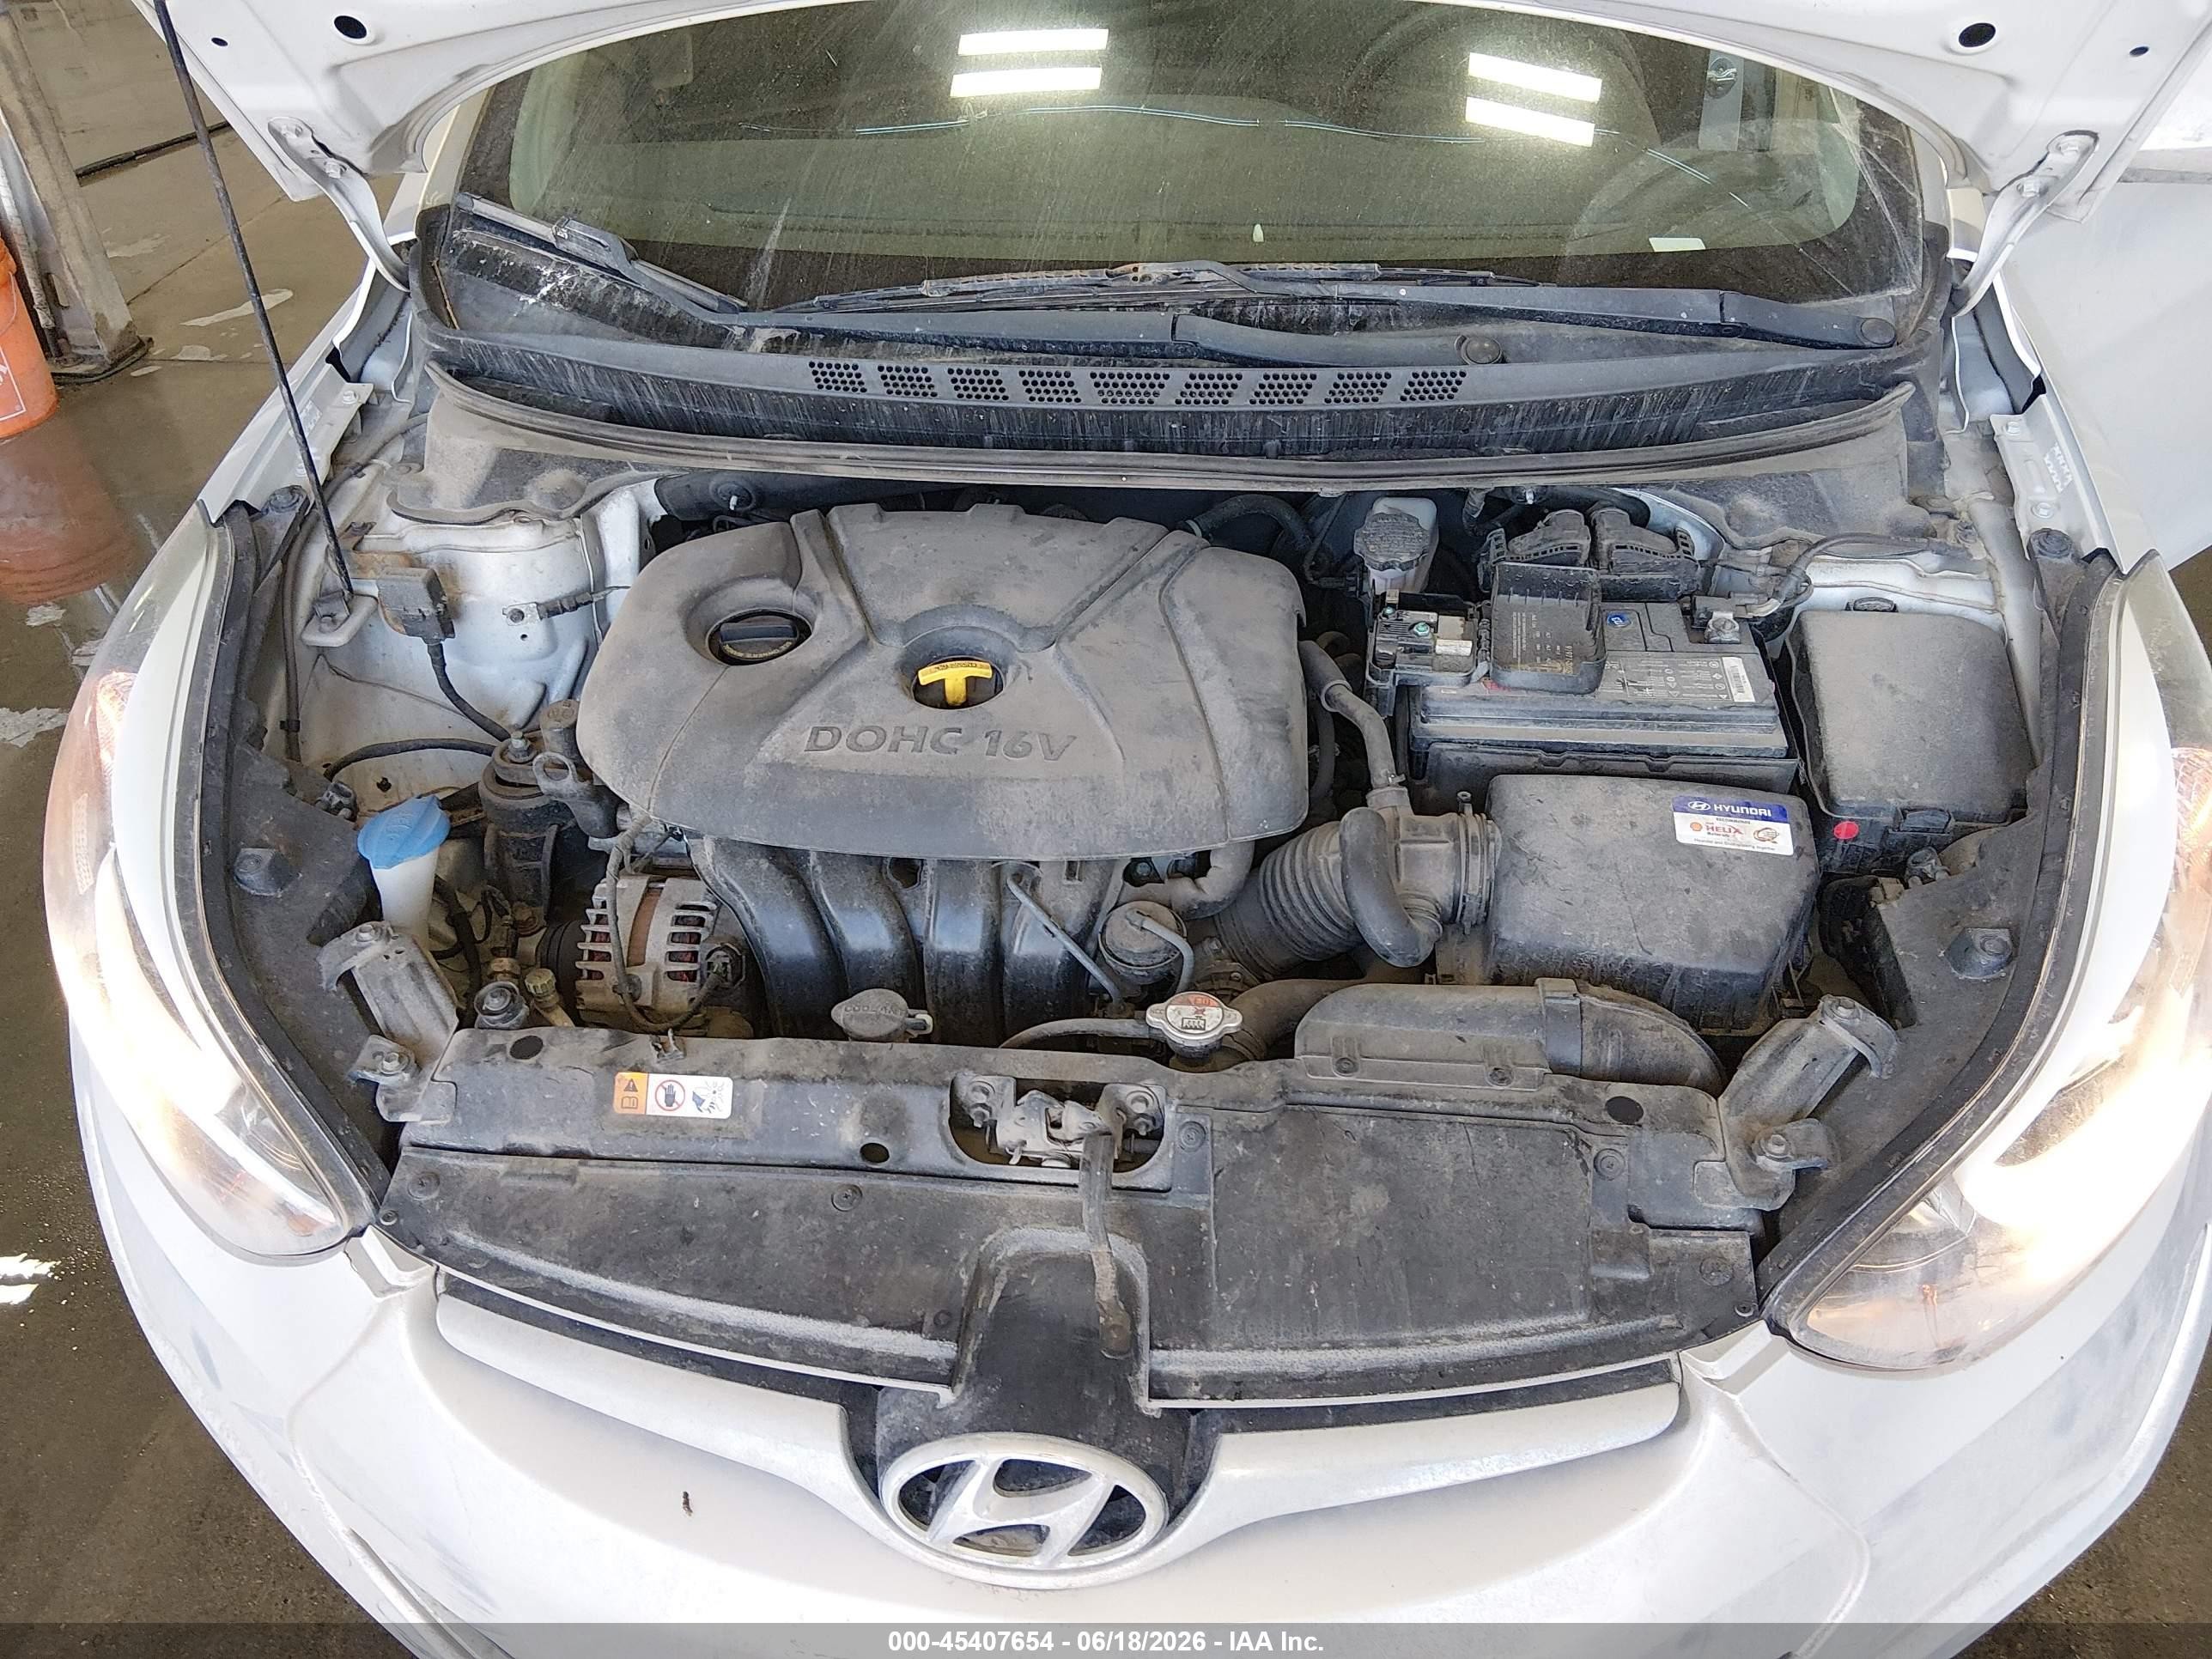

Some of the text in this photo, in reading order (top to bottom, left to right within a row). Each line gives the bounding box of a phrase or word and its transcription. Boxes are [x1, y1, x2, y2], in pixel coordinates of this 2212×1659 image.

[804, 726, 1077, 761] DOHC 16V
[1713, 803, 1772, 817] HYUNDAI
